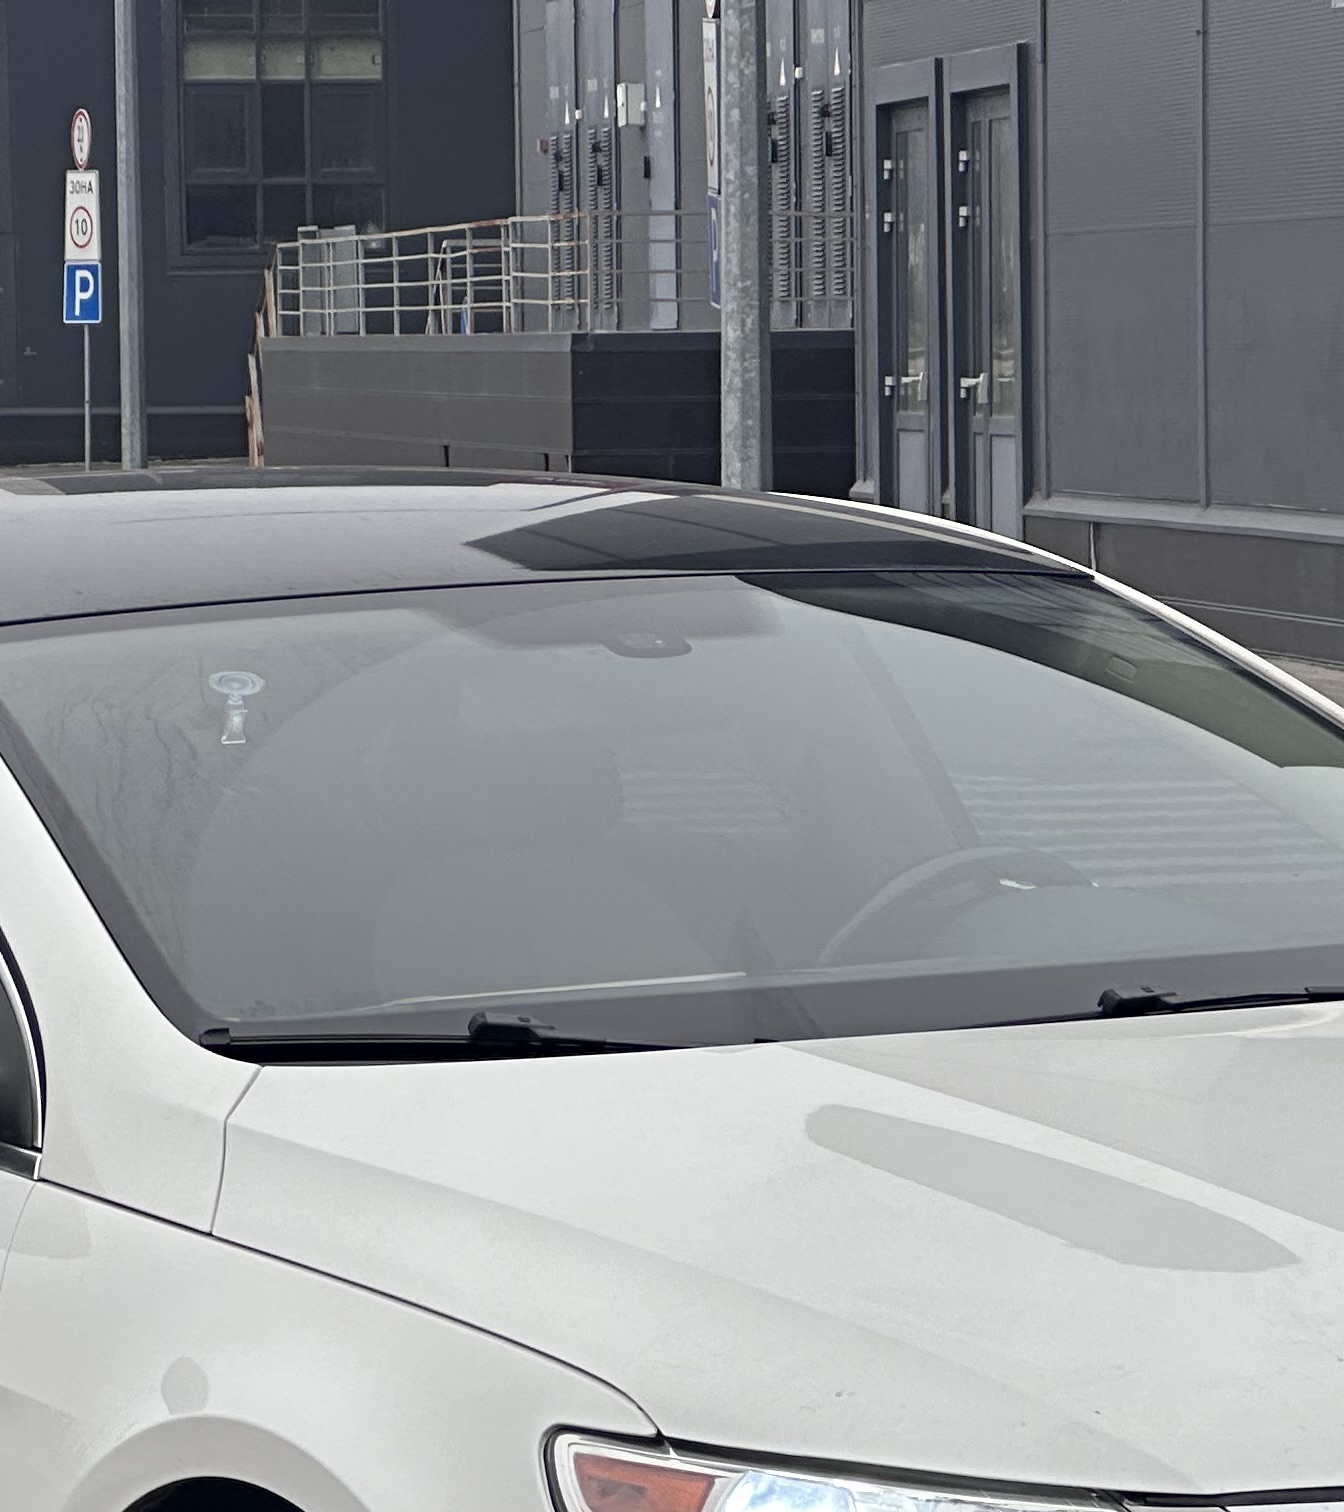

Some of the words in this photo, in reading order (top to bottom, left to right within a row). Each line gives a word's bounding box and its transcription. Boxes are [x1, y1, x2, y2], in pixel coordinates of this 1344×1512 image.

[69, 180, 94, 195] ЗОНА
[74, 218, 88, 236] 10
[74, 269, 95, 316] P
